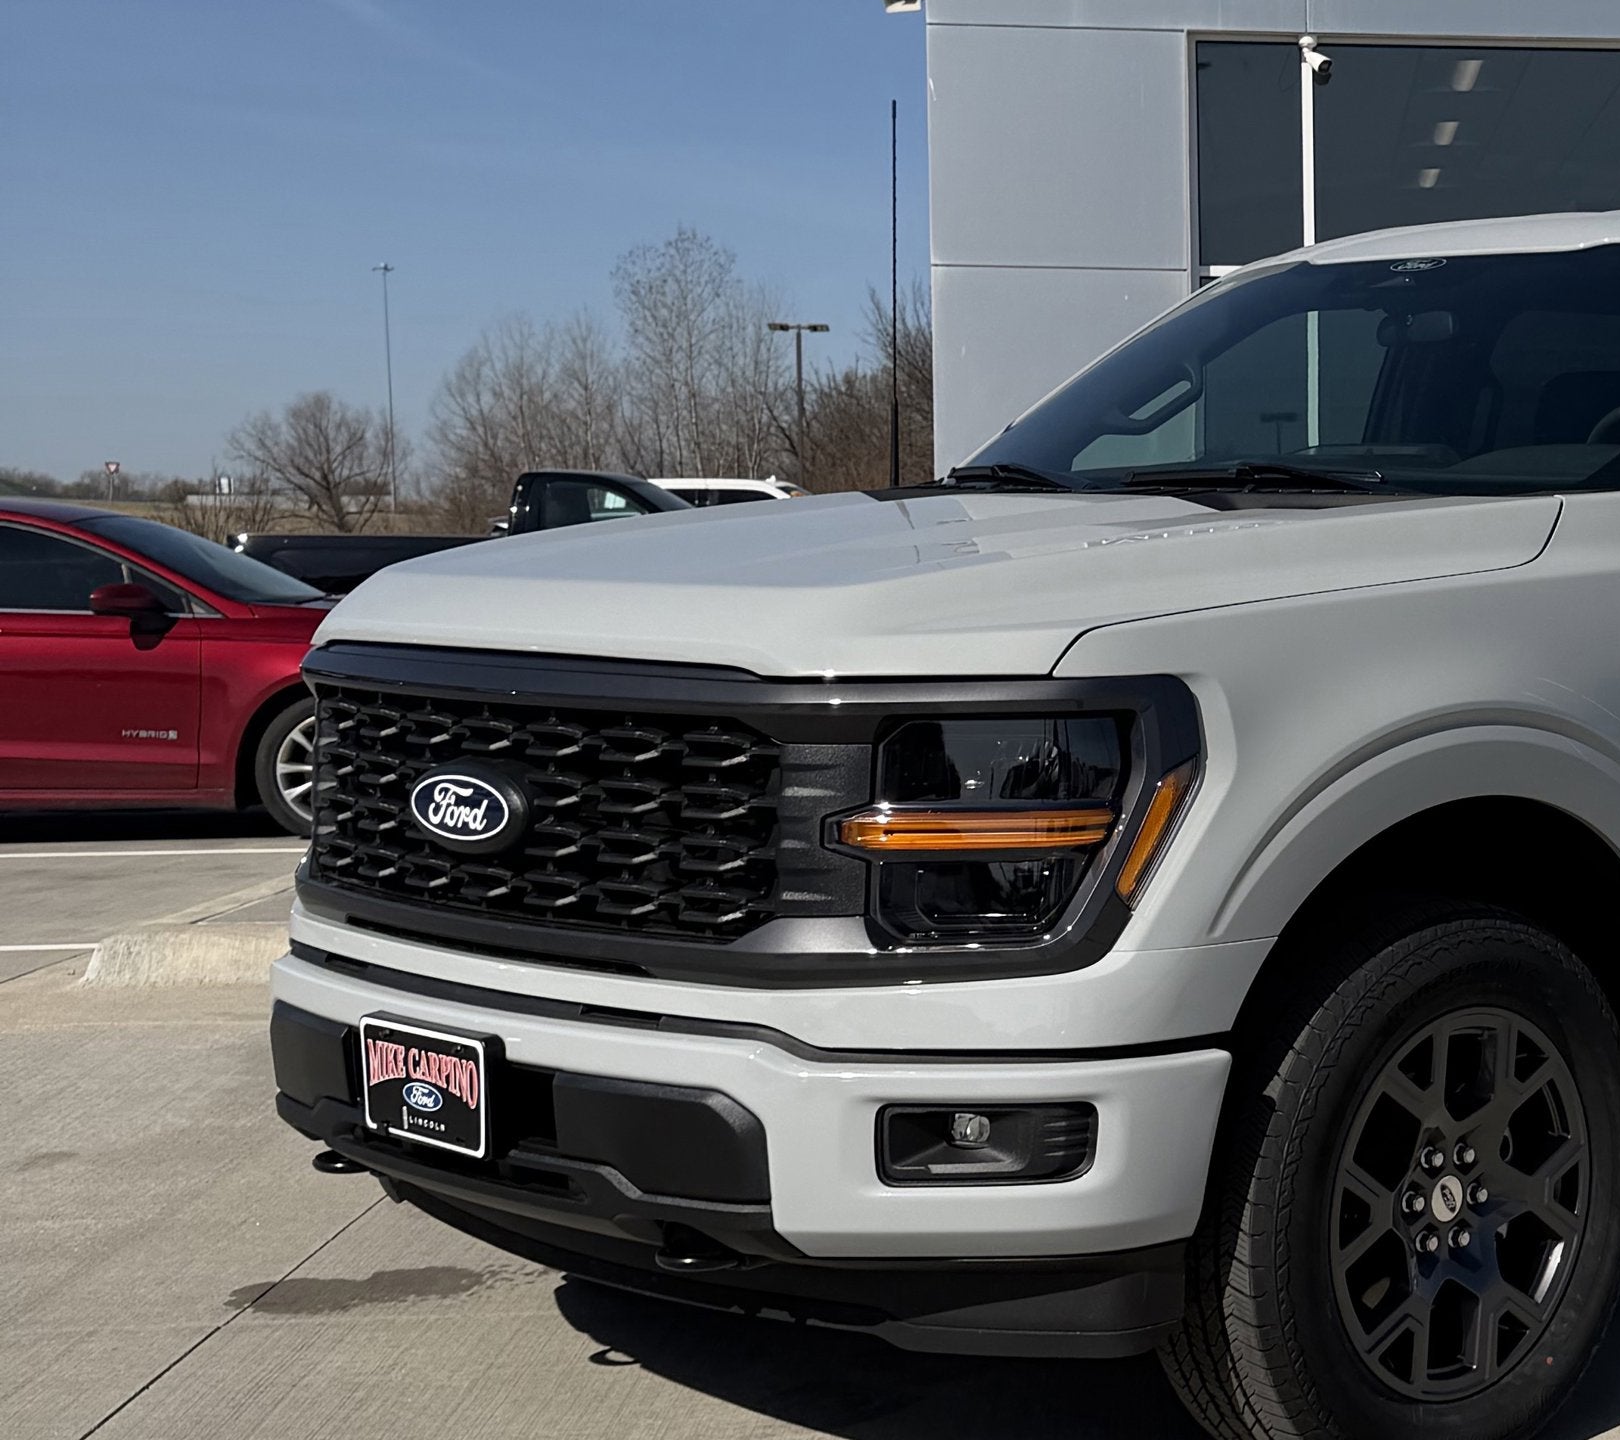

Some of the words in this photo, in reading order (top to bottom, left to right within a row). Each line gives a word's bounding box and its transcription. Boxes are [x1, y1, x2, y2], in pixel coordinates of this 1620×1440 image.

[121, 729, 168, 740] HYBRID
[428, 782, 489, 831] Ford
[366, 1038, 406, 1087] MIKE
[407, 1047, 478, 1109] CARPINO
[410, 1085, 436, 1107] Ford
[409, 1115, 446, 1132] LINCOLN
